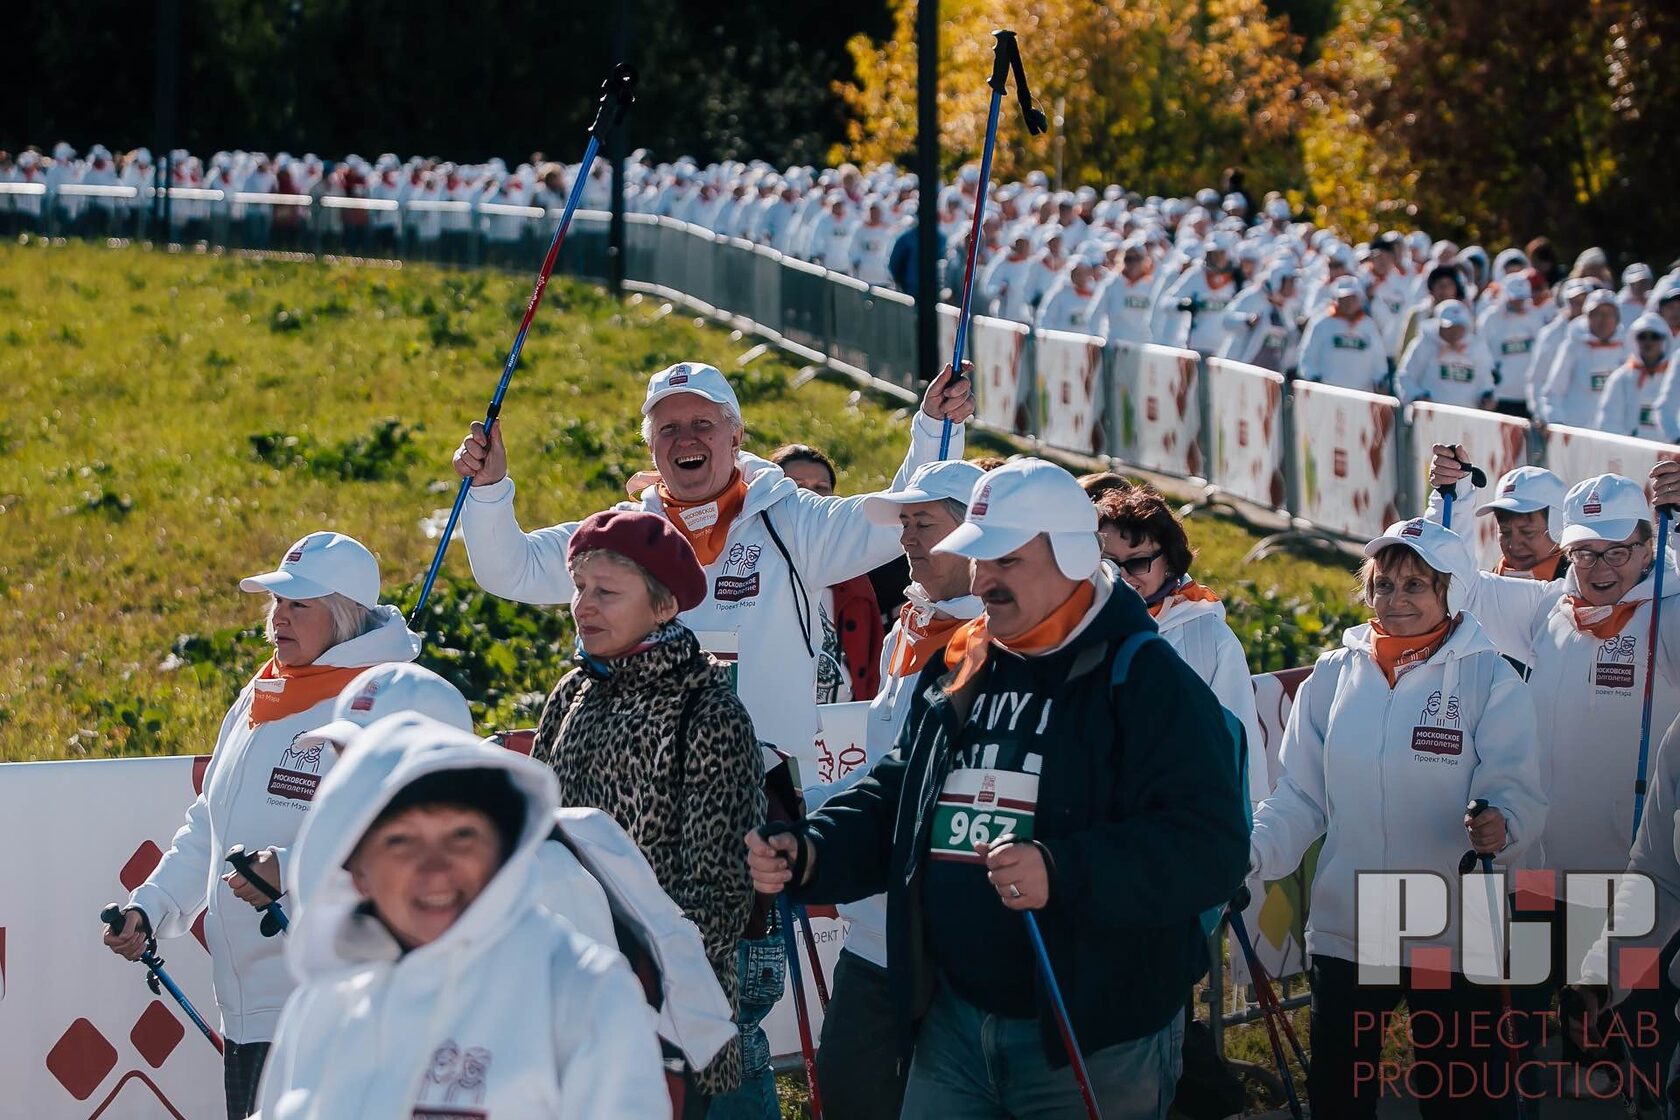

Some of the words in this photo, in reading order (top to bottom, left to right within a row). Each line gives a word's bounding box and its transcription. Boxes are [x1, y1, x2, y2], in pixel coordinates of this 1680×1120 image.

[718, 576, 757, 588] МОСКОВСКОЕ
[716, 602, 740, 612] Проект
[740, 600, 756, 608] Мэра
[1416, 731, 1460, 742] МОСКОВСКОЕ
[1414, 754, 1440, 764] Проект
[1441, 756, 1459, 766] Мэра
[273, 772, 317, 788] МОСКОВСКОЕ
[267, 797, 290, 808] Проект
[948, 811, 1018, 847] 967
[797, 929, 839, 946] Поект
